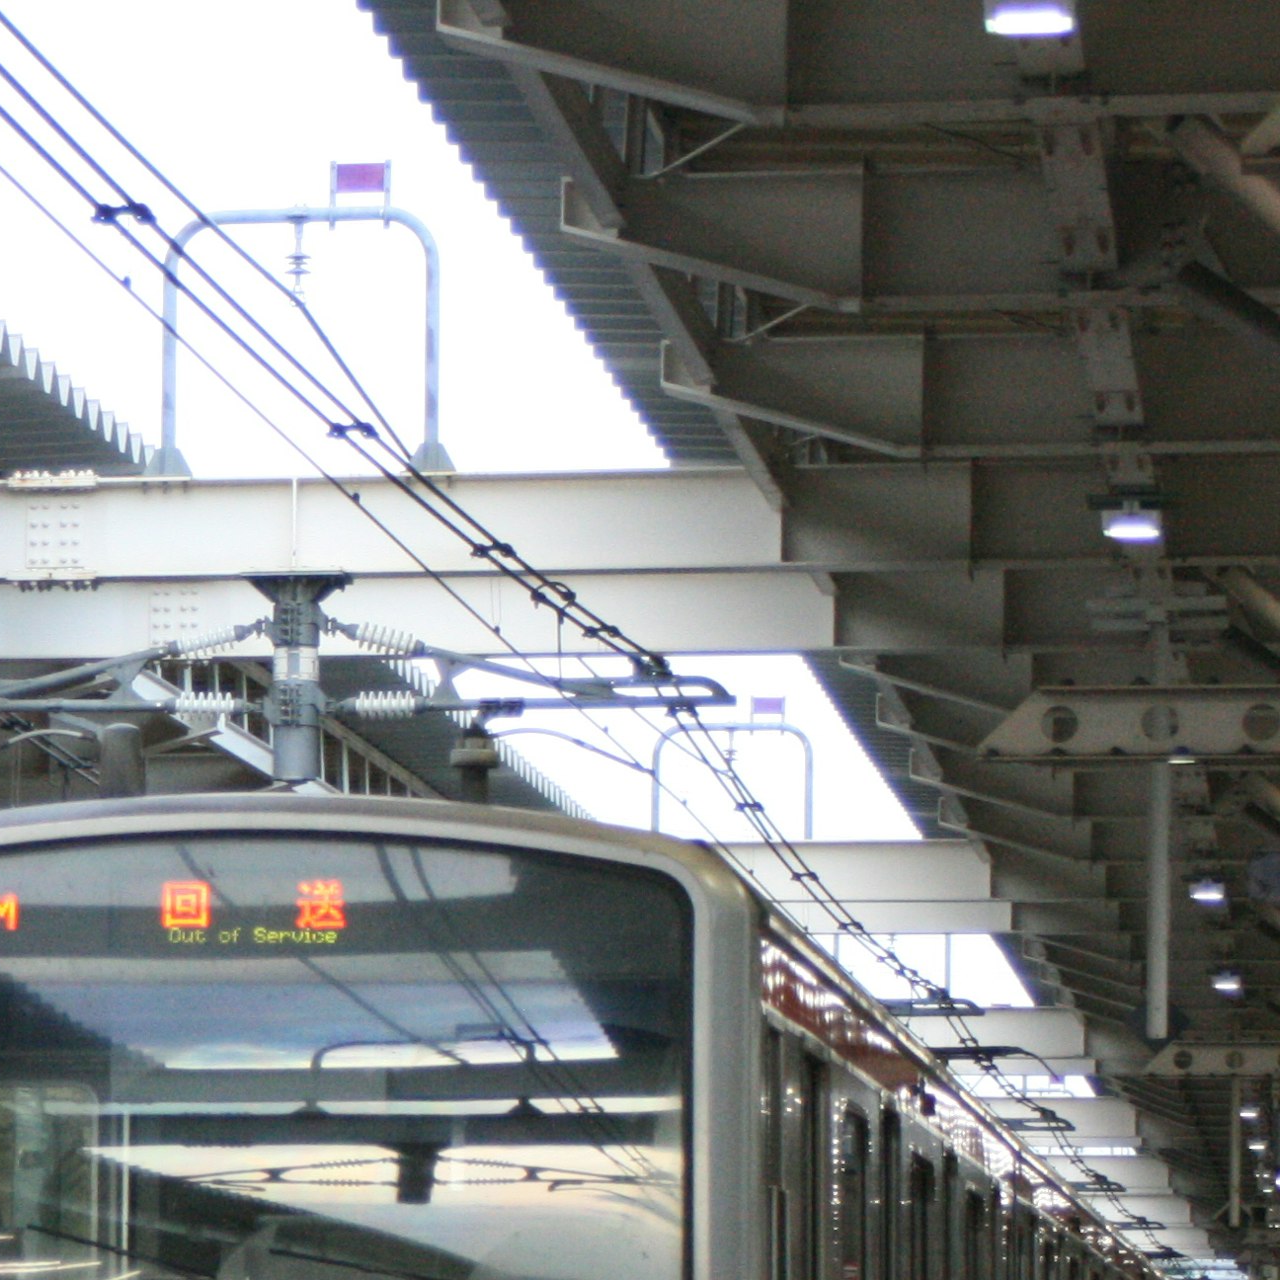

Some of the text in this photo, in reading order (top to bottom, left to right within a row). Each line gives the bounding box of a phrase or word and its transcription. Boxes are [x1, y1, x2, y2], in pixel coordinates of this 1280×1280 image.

[169, 926, 338, 943] Out of Service
